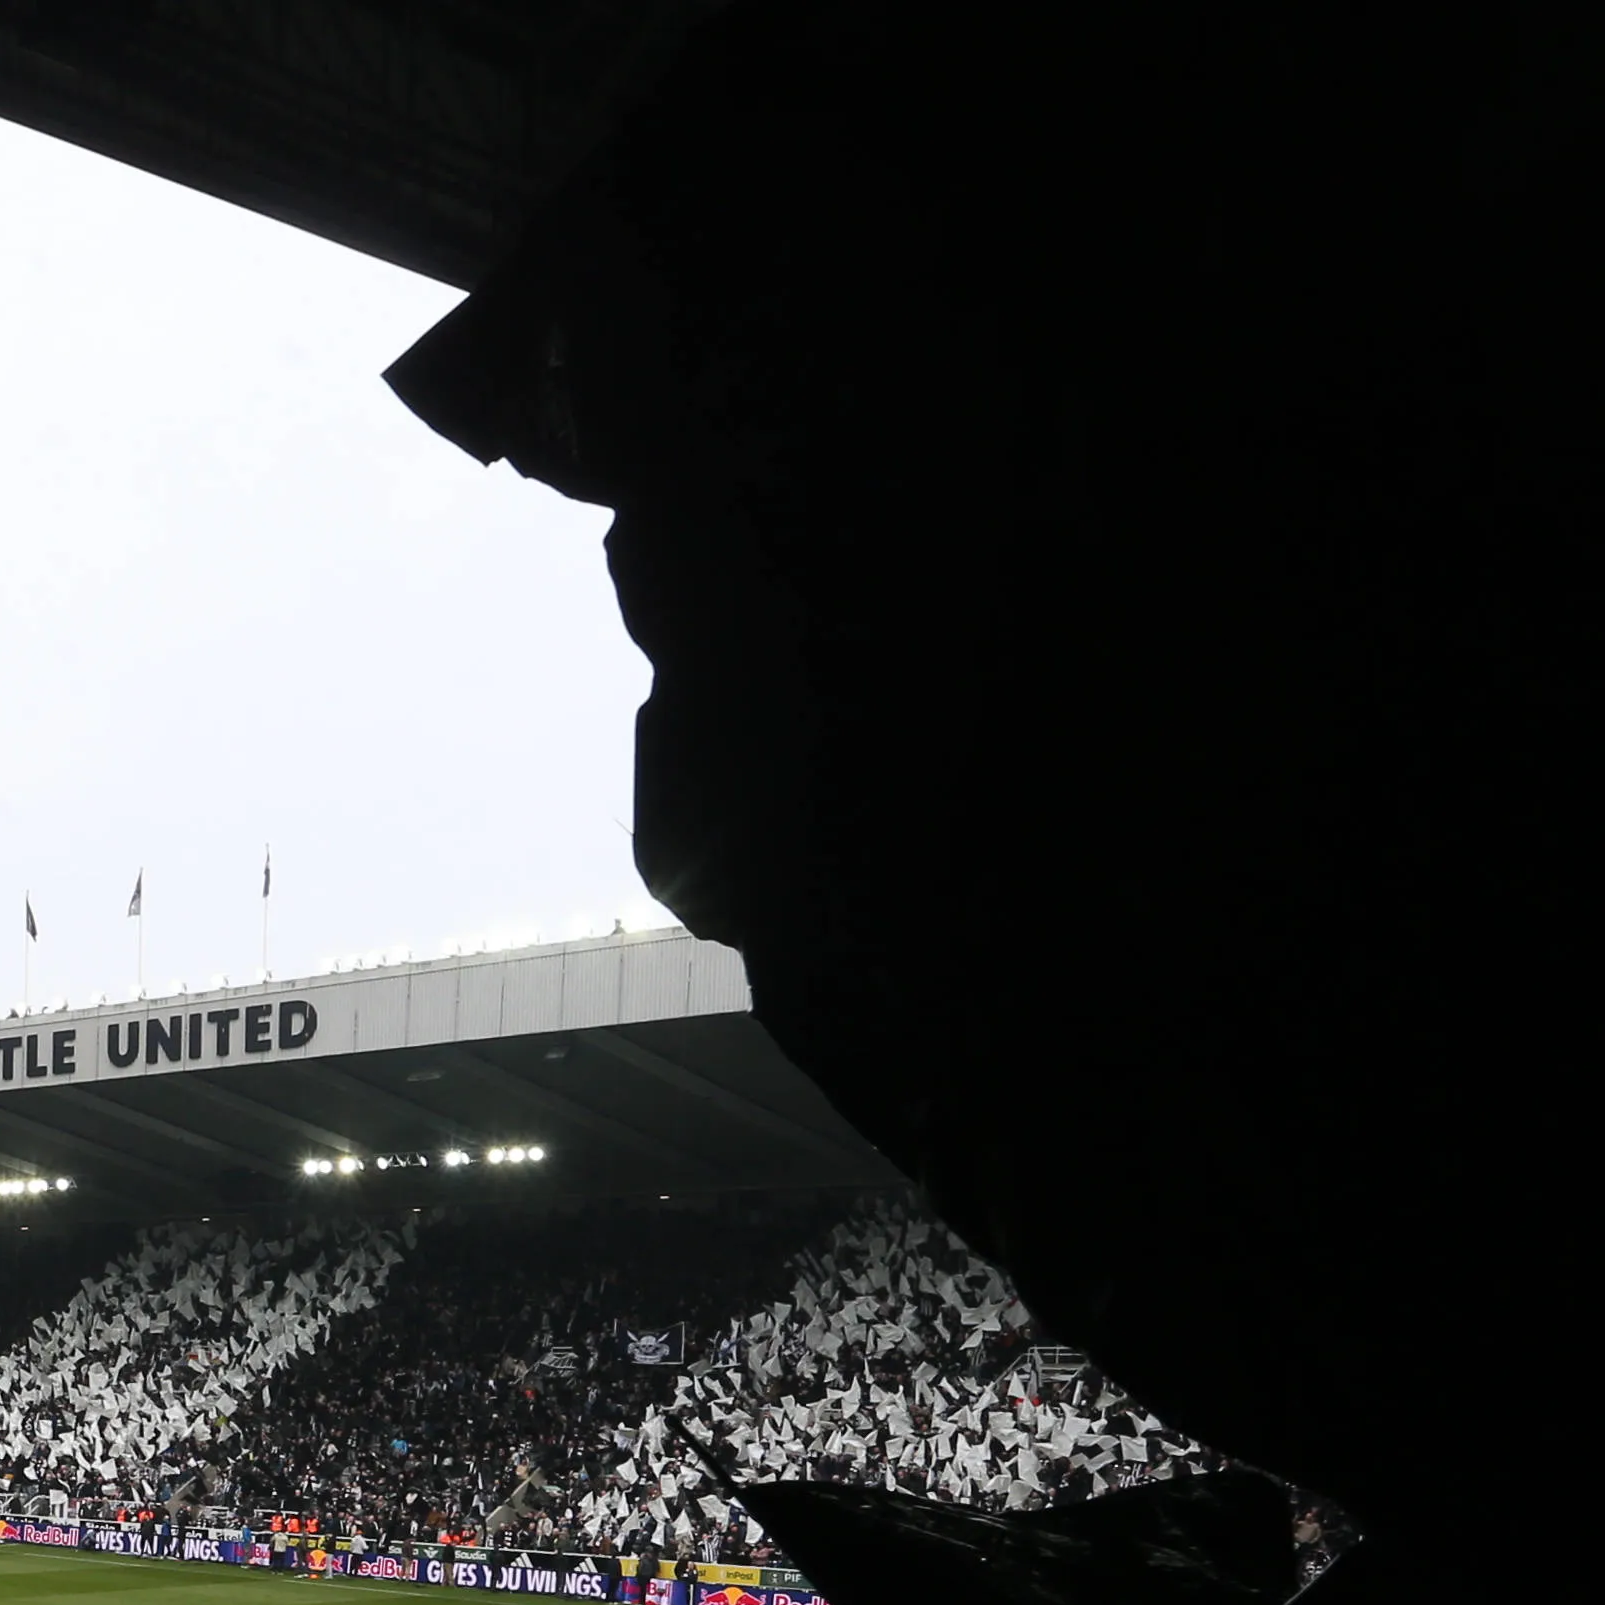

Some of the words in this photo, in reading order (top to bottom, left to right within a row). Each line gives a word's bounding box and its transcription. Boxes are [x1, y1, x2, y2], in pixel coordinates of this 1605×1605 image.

[107, 1000, 318, 1068] UNITED
[23, 1524, 50, 1543] Red
[50, 1526, 80, 1547] Bull
[455, 1550, 487, 1560] Saudia
[726, 1571, 754, 1580] InPost
[784, 1572, 803, 1583] PIF
